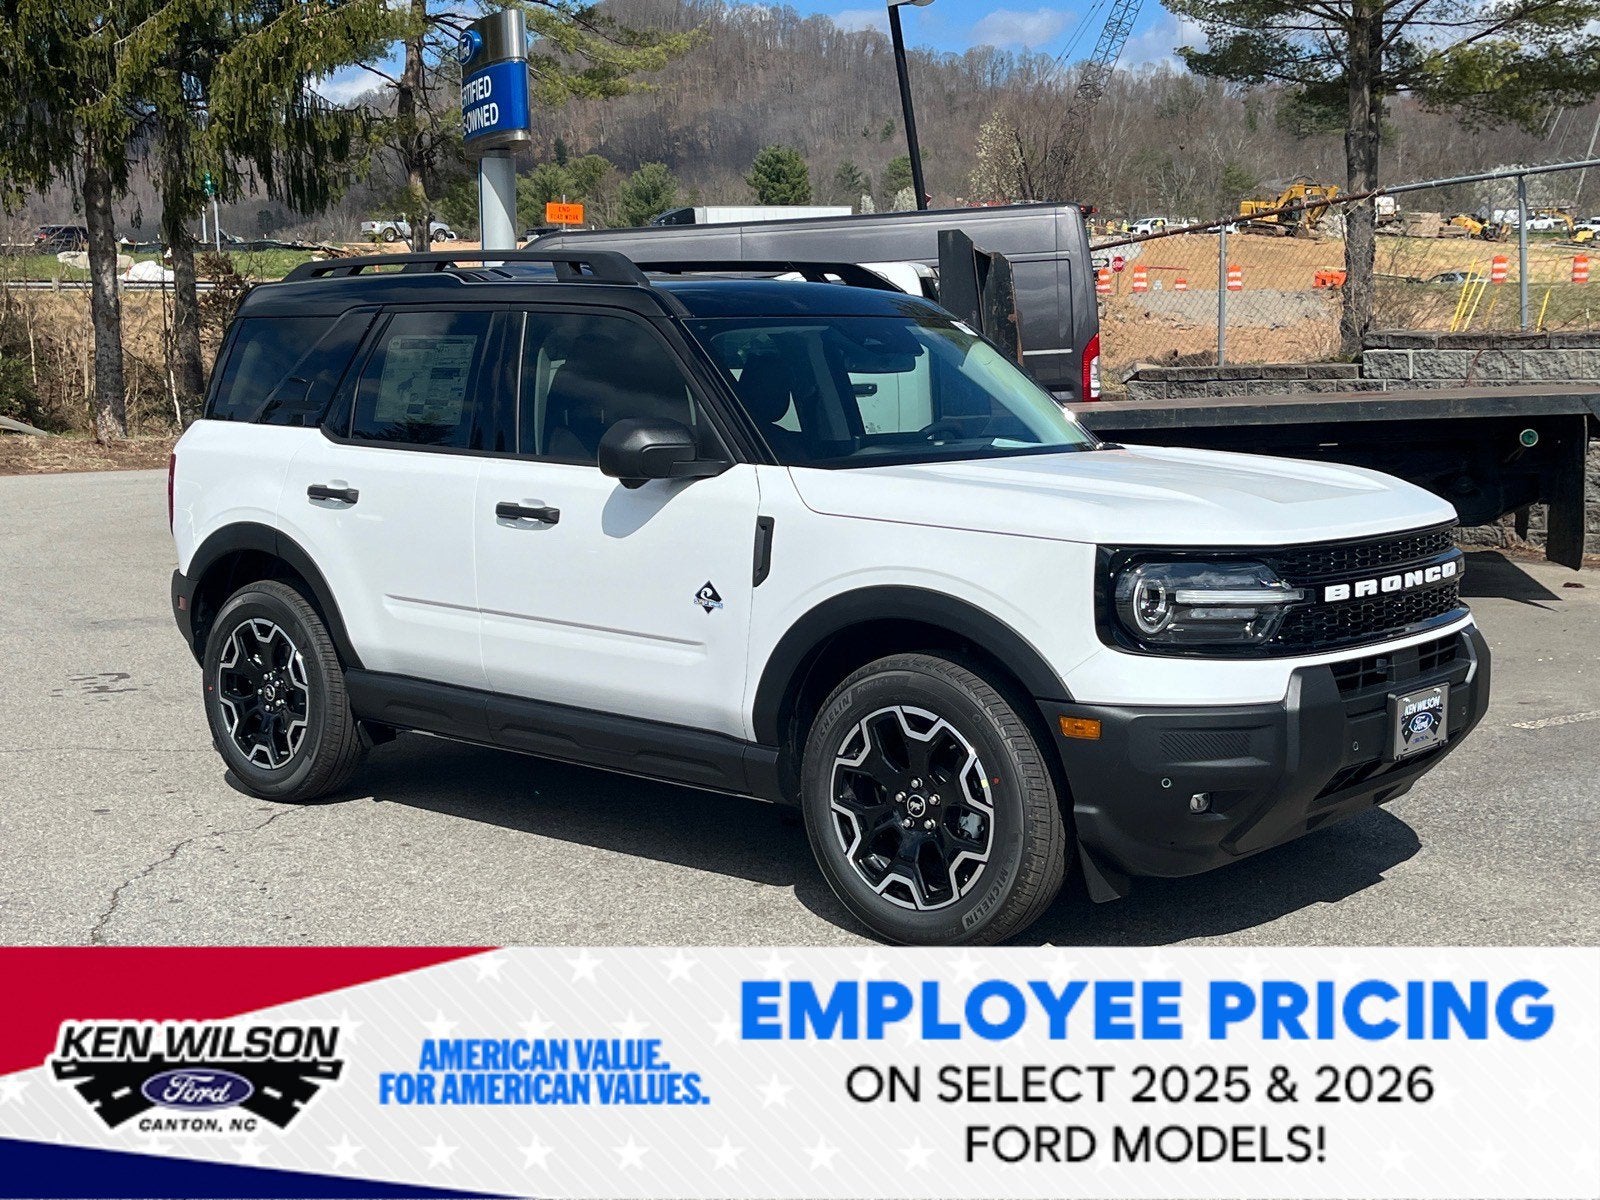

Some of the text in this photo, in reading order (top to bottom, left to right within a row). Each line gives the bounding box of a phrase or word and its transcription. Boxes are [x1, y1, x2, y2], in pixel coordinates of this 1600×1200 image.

[462, 75, 492, 107] RTIFIED
[1324, 561, 1457, 603] BRONCO
[964, 866, 1010, 927] MICHELIN
